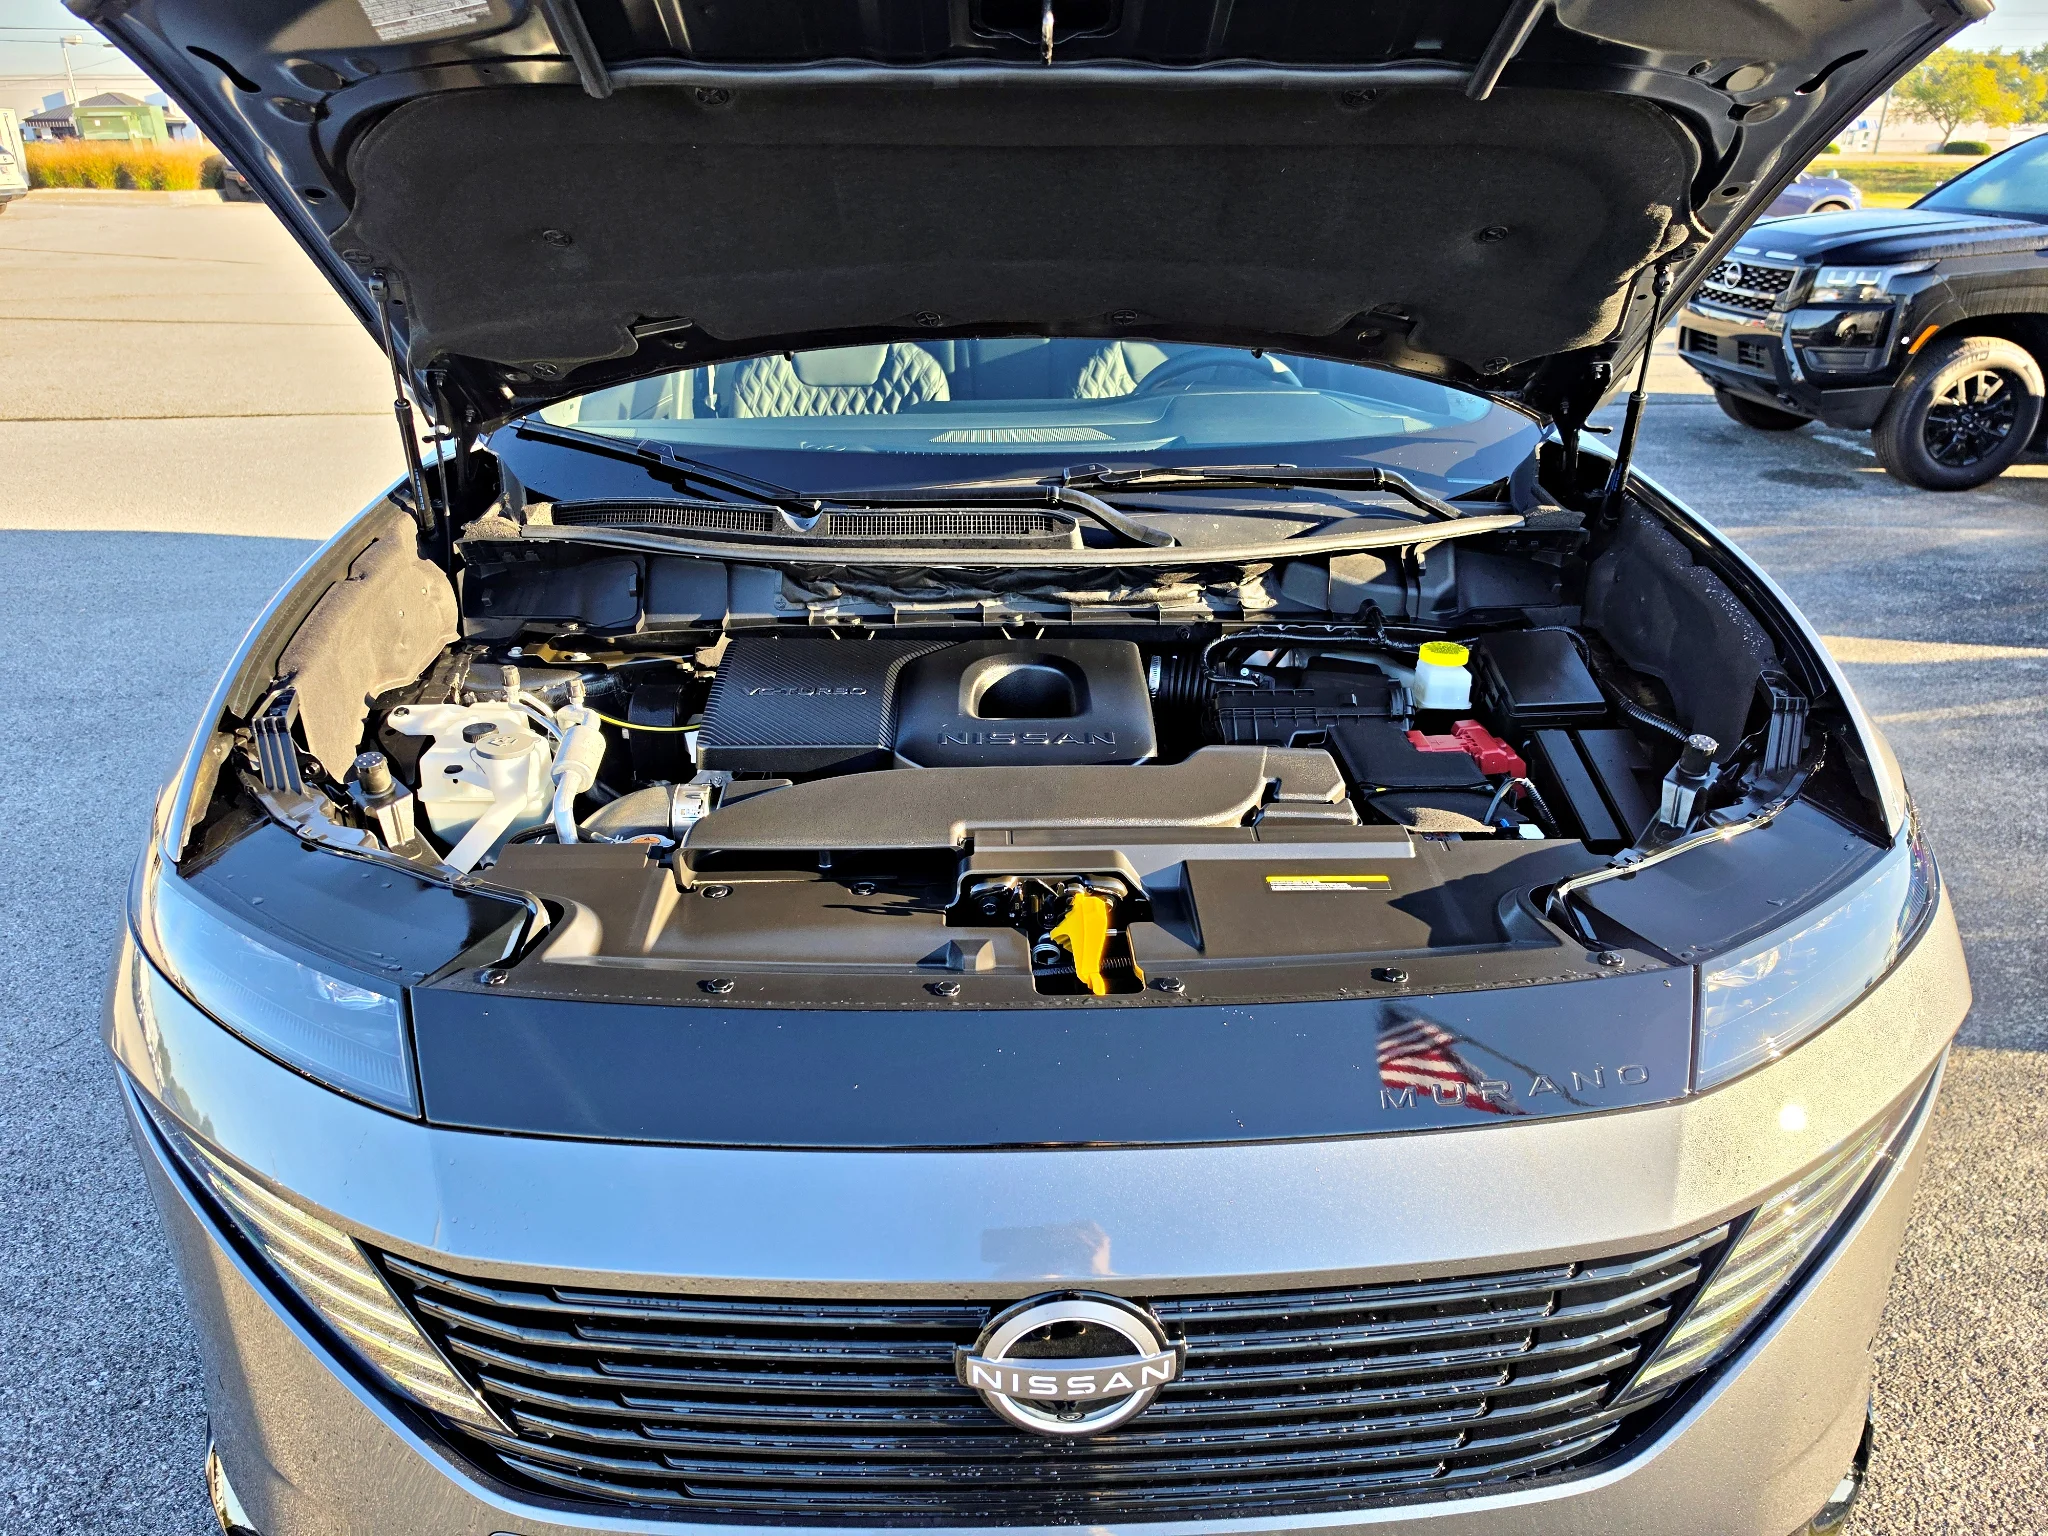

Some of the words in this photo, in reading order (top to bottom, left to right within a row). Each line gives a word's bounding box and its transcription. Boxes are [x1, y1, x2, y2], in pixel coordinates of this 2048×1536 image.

[937, 731, 1117, 746] NISSAN
[1379, 1063, 1650, 1110] MURANO
[971, 1359, 1171, 1396] NISSAN
